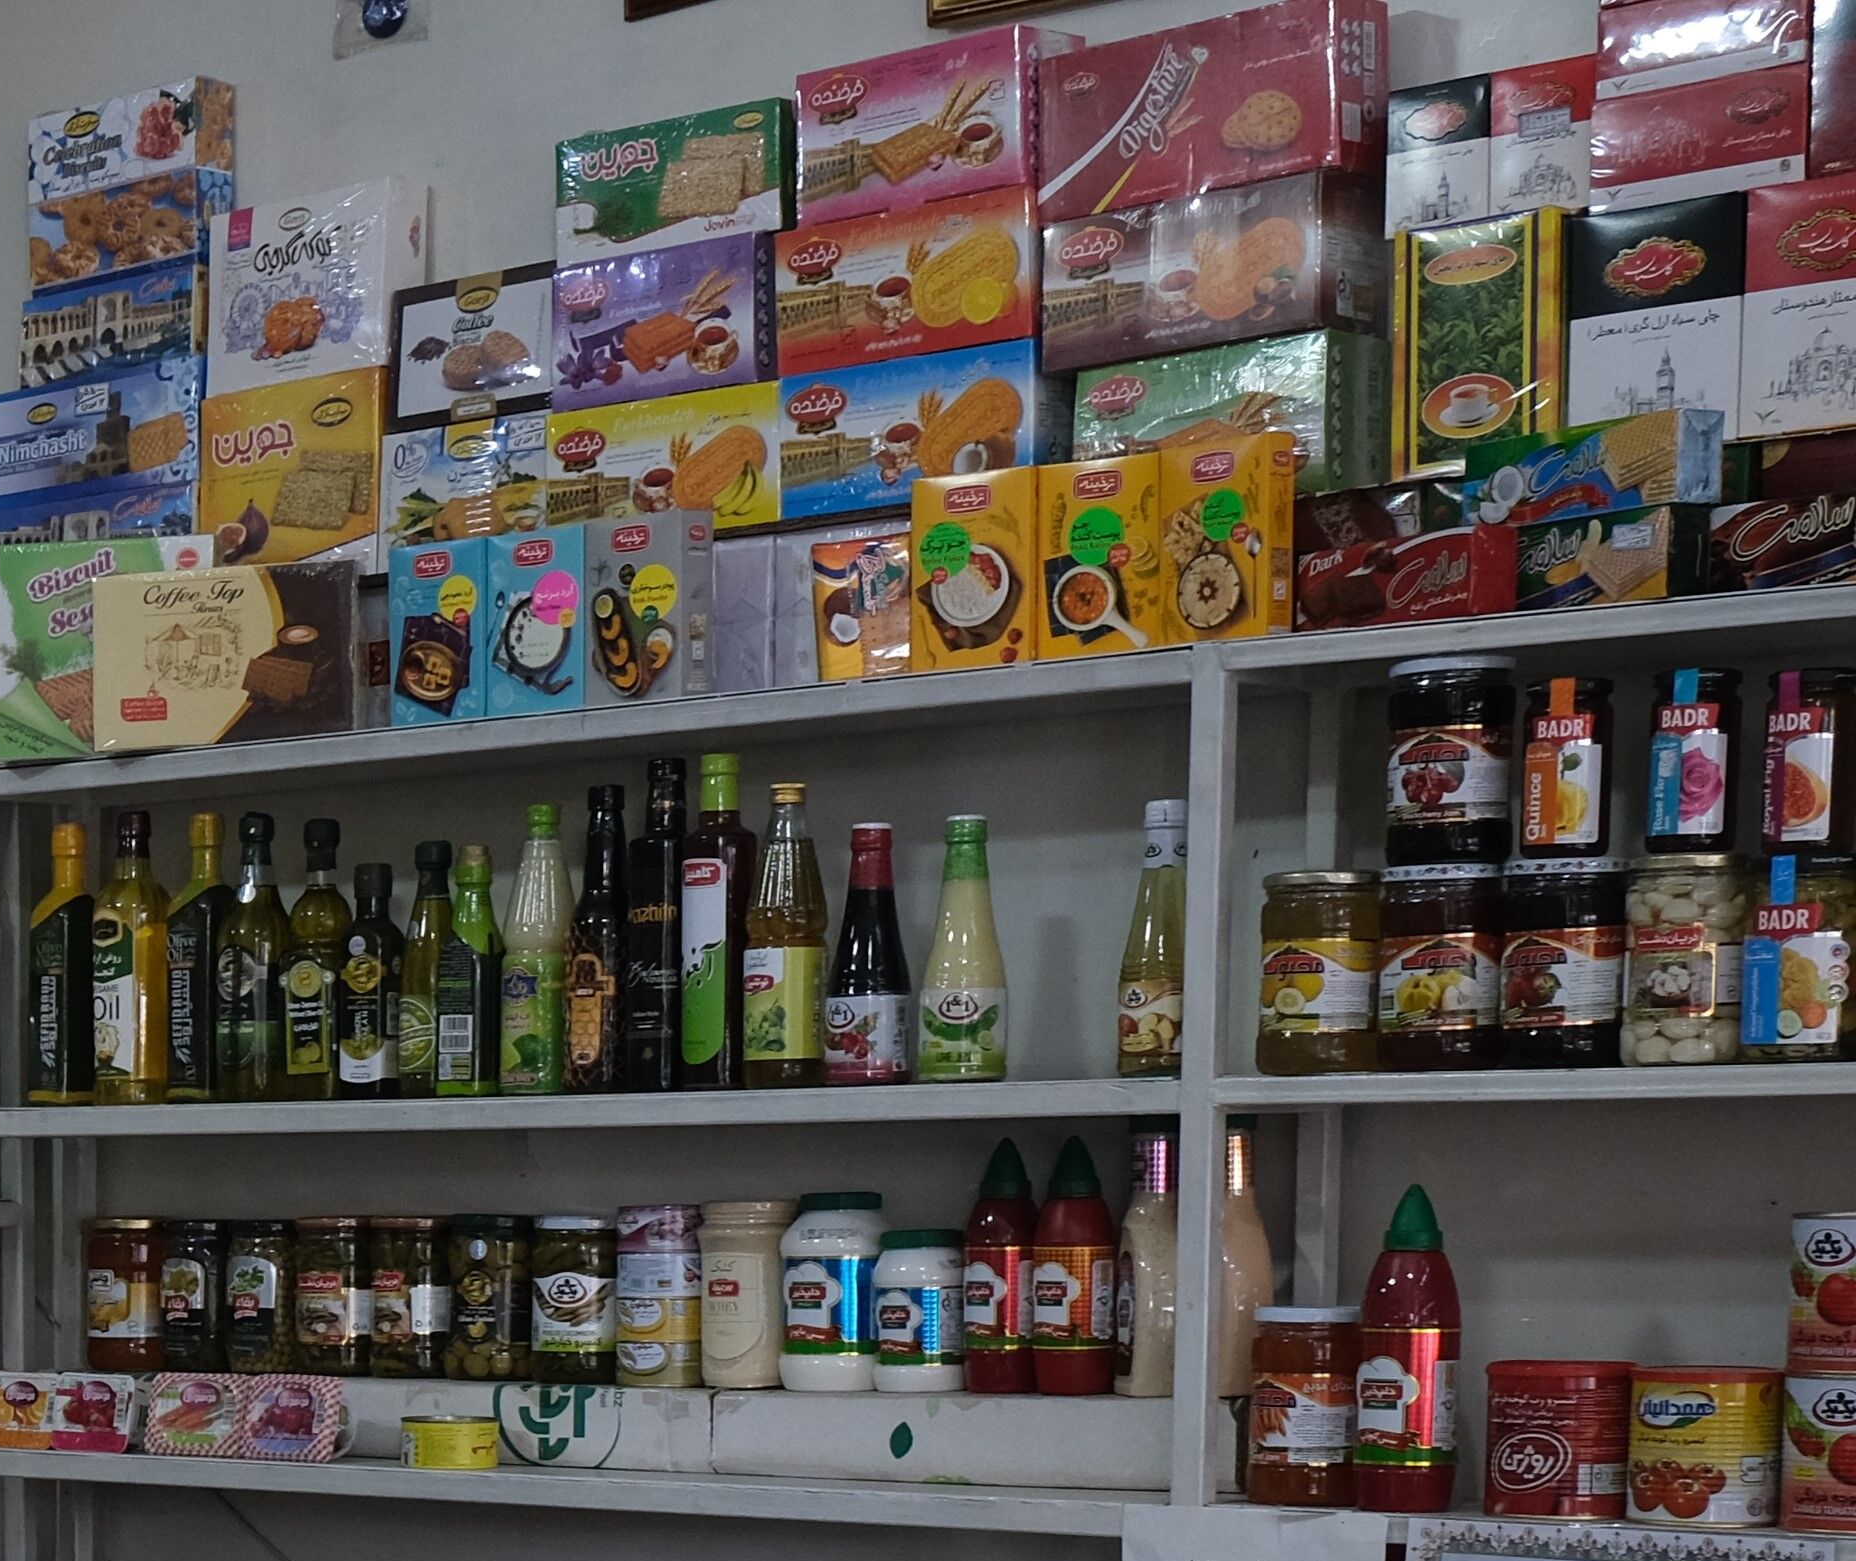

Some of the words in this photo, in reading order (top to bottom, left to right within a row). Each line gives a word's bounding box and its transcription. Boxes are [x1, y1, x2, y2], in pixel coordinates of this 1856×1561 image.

[1119, 49, 1186, 157] Digestive
[580, 137, 658, 182] جوین
[214, 422, 295, 466] جوین
[29, 550, 114, 599] Biscuit
[1308, 548, 1344, 578] Dark
[144, 584, 200, 609] Coffee
[209, 580, 244, 604] Top
[1537, 719, 1586, 739] BADR
[1661, 709, 1709, 728] BADR
[1768, 712, 1812, 733] BADR
[1525, 772, 1543, 841] Quince
[1758, 908, 1810, 932] BADR
[94, 995, 119, 1021] Oil
